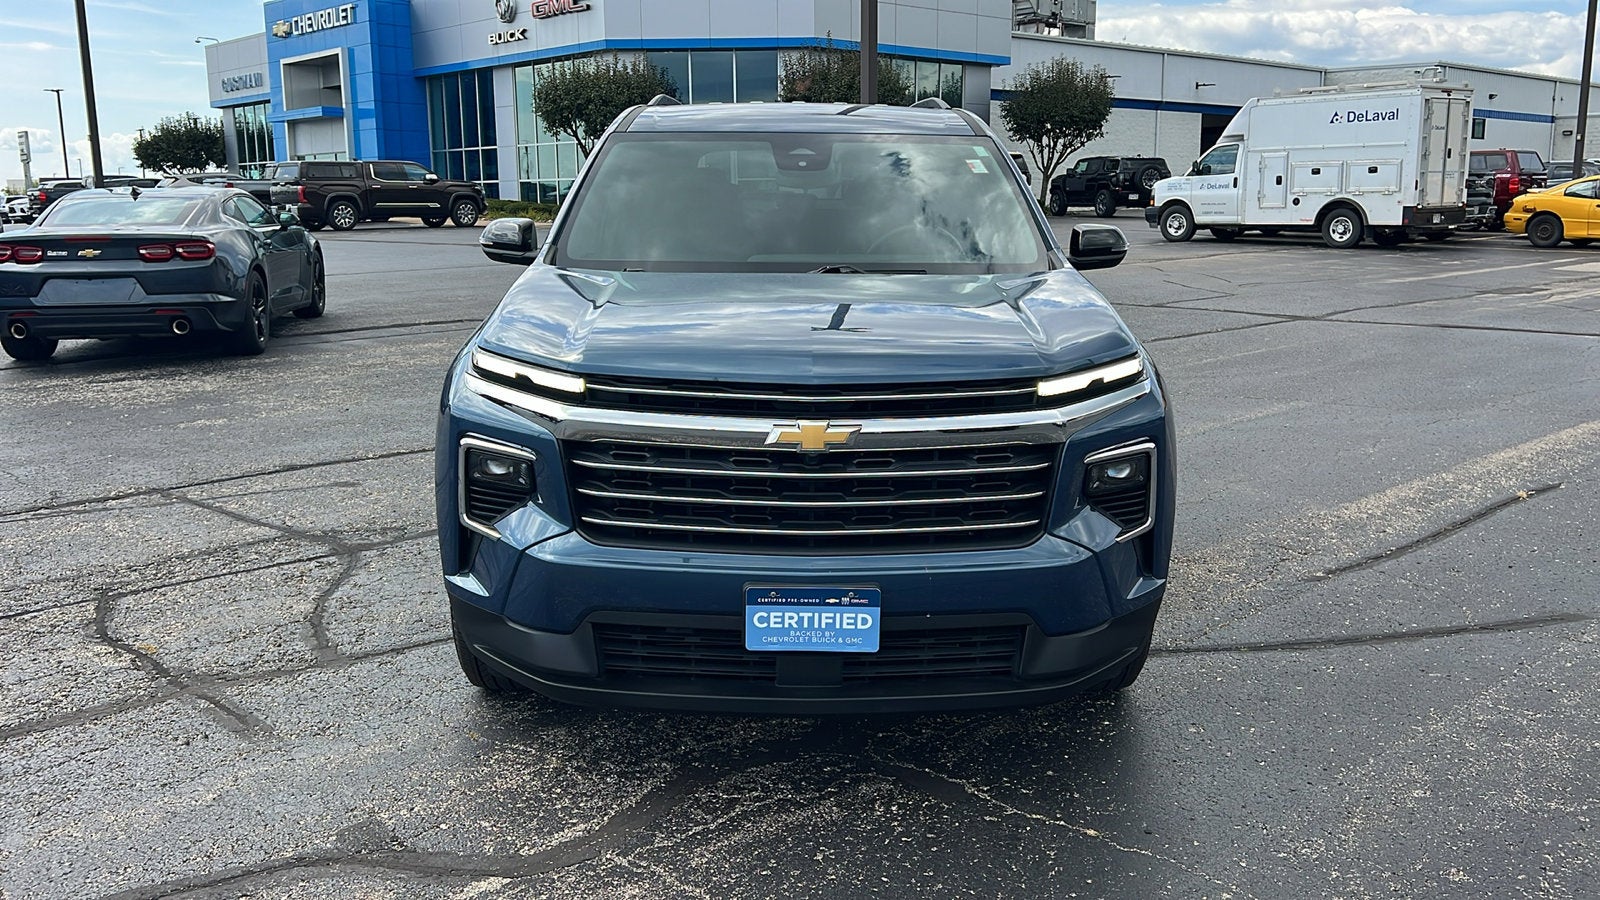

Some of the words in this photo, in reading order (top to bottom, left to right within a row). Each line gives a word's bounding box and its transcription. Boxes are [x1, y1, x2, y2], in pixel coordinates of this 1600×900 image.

[531, 0, 587, 19] GMC
[292, 4, 354, 35] CHEVROLET
[487, 27, 526, 45] BUICK
[1347, 107, 1399, 123] DeLaval
[1206, 182, 1230, 190] DeLaval
[753, 612, 873, 629] CERTIFIED
